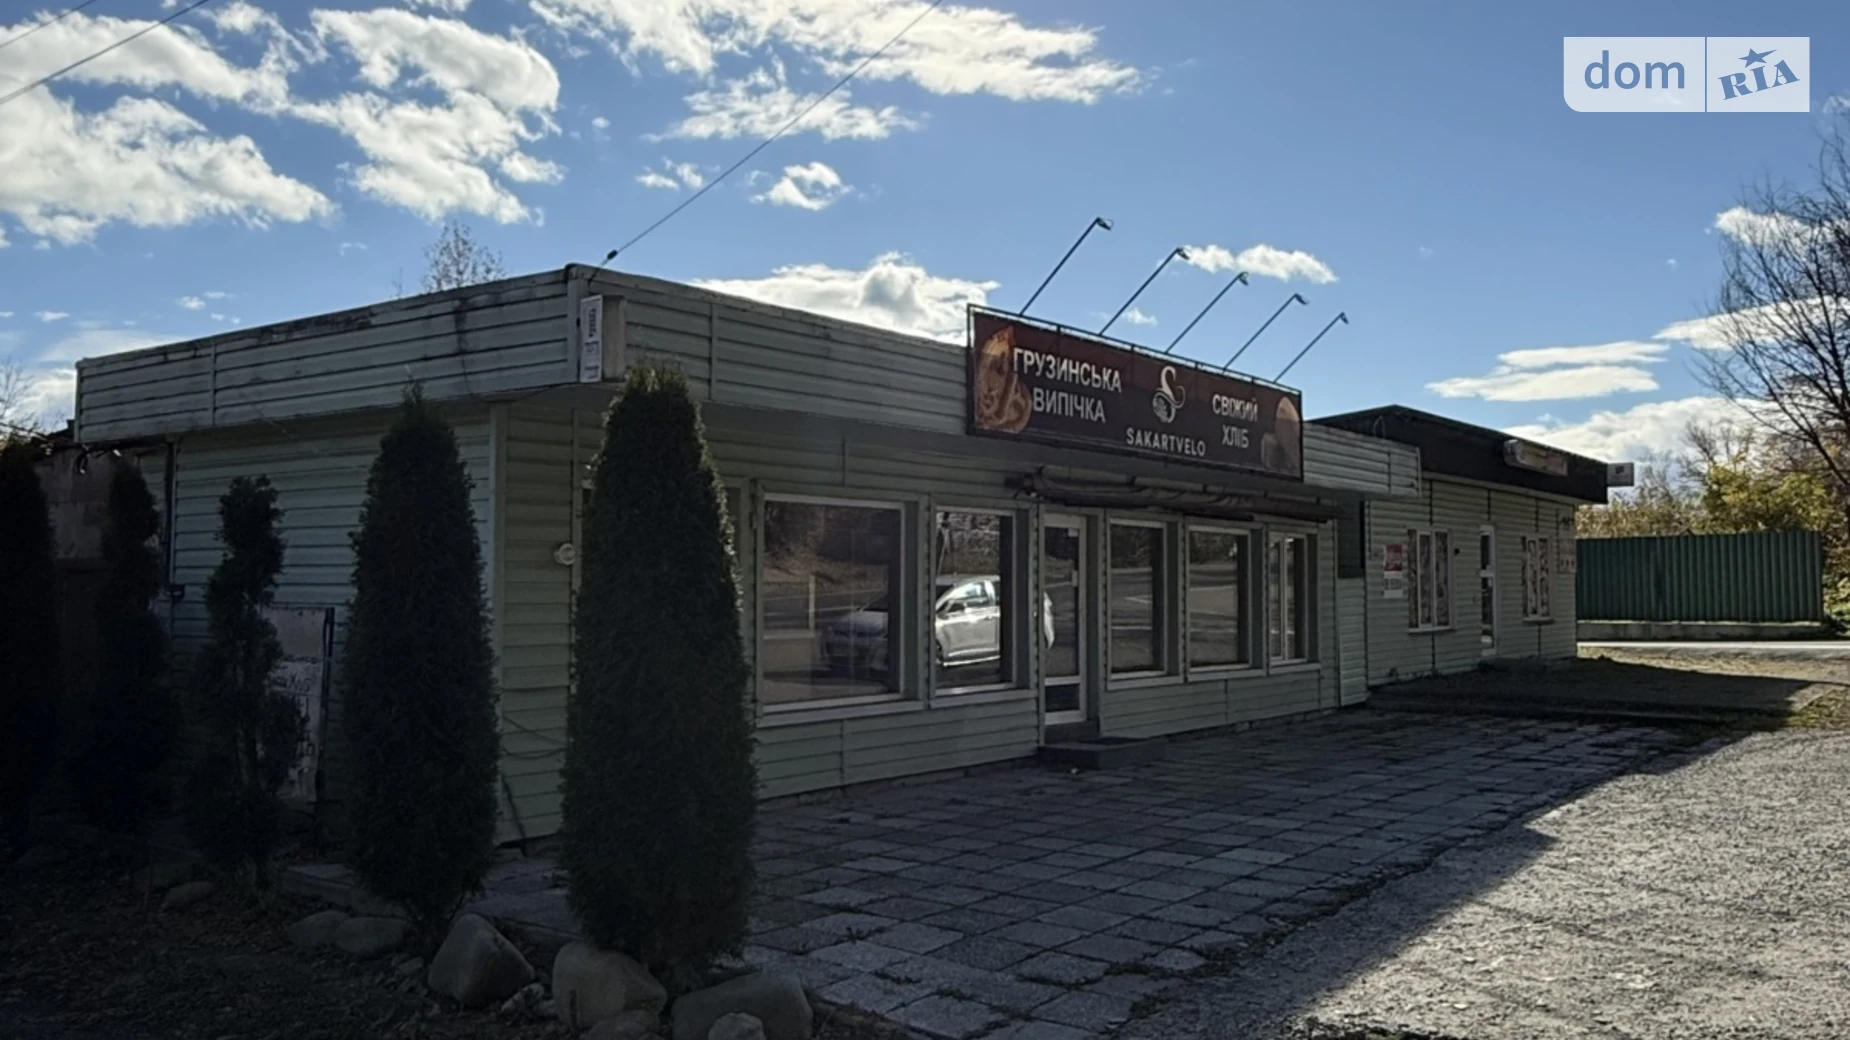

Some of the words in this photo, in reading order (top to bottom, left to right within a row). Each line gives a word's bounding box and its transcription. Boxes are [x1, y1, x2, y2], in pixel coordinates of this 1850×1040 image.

[1013, 347, 1122, 393] ГРУЗИНСЬКА
[1033, 387, 1106, 423] ВИПІЧКА
[1126, 427, 1206, 457] SAKARTVELO
[1222, 424, 1249, 449] ХЛІБ
